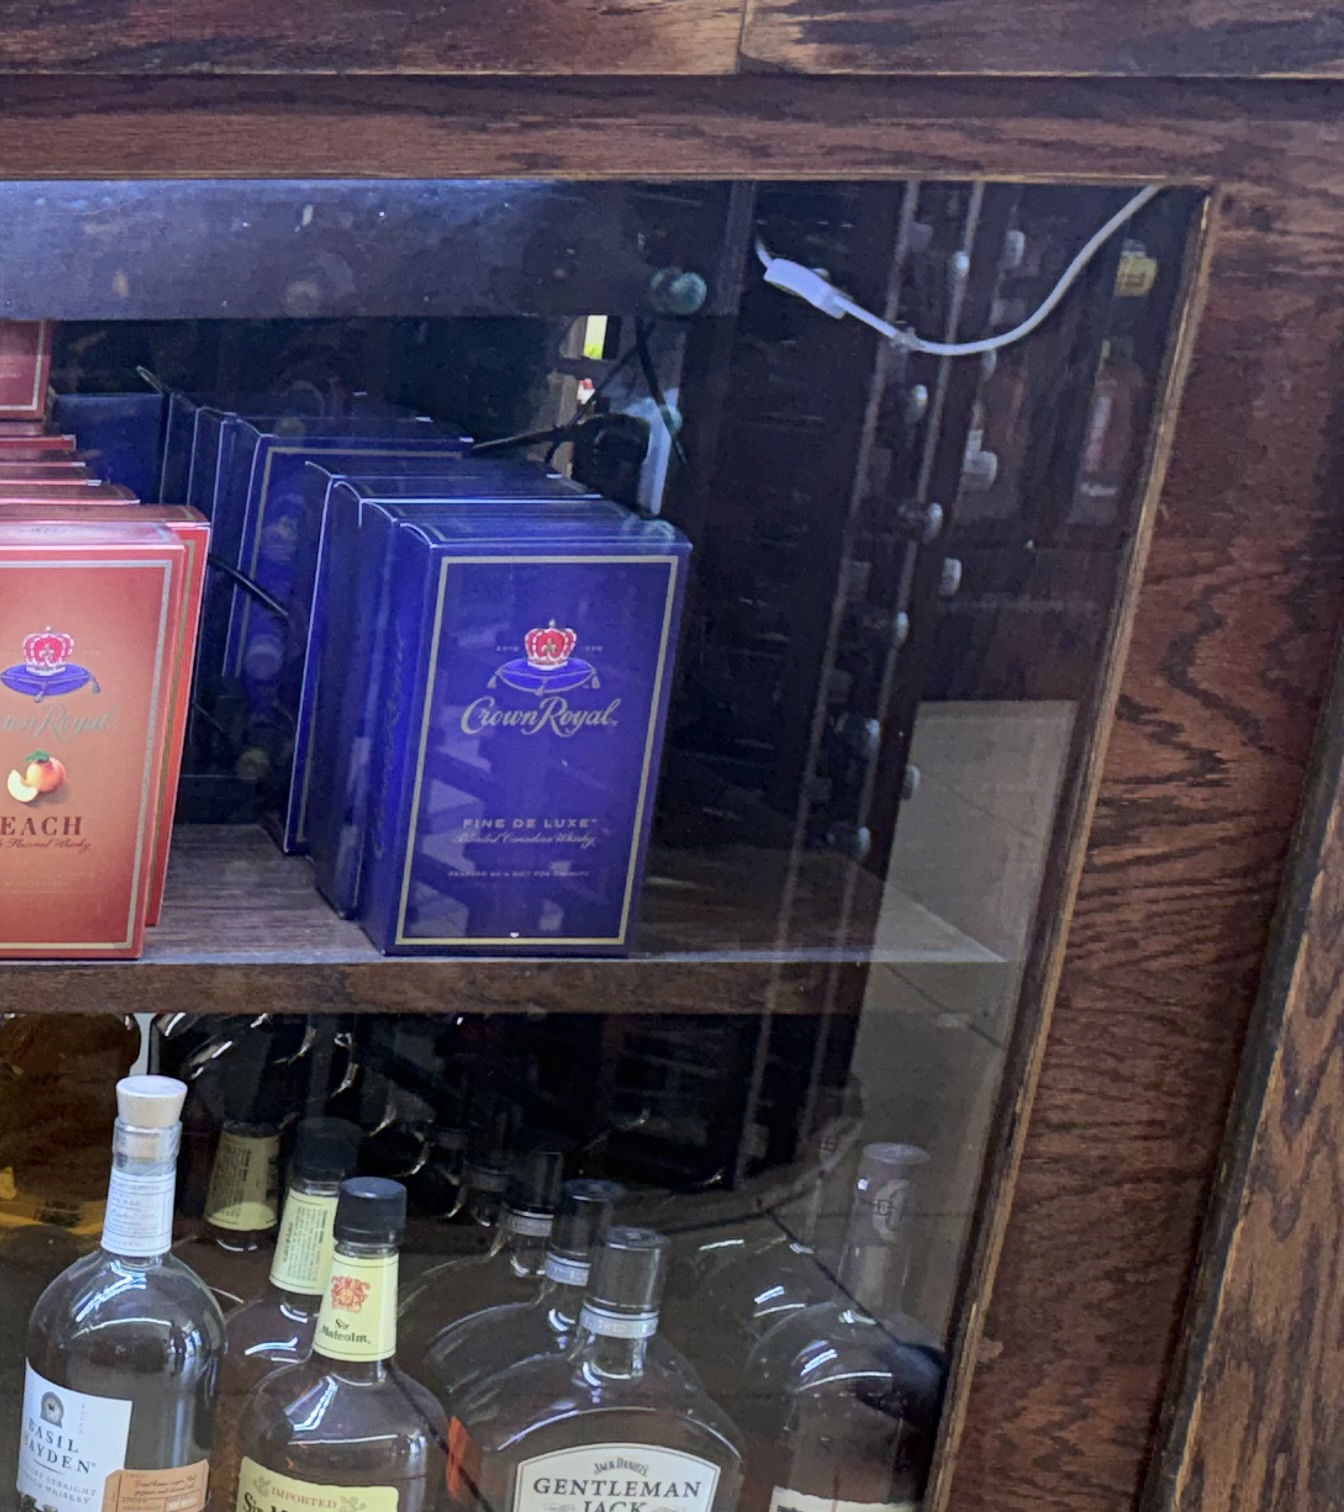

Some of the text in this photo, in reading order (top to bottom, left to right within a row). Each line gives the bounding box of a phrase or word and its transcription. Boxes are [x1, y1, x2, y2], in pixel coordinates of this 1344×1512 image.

[32, 703, 119, 743] Royal
[460, 695, 622, 738] Crown Royal
[462, 818, 591, 829] FINE DE LUXE
[319, 1324, 368, 1343] Malcolm
[270, 1486, 338, 1510] IMPORTED
[532, 1477, 702, 1498] GENTLEMAN
